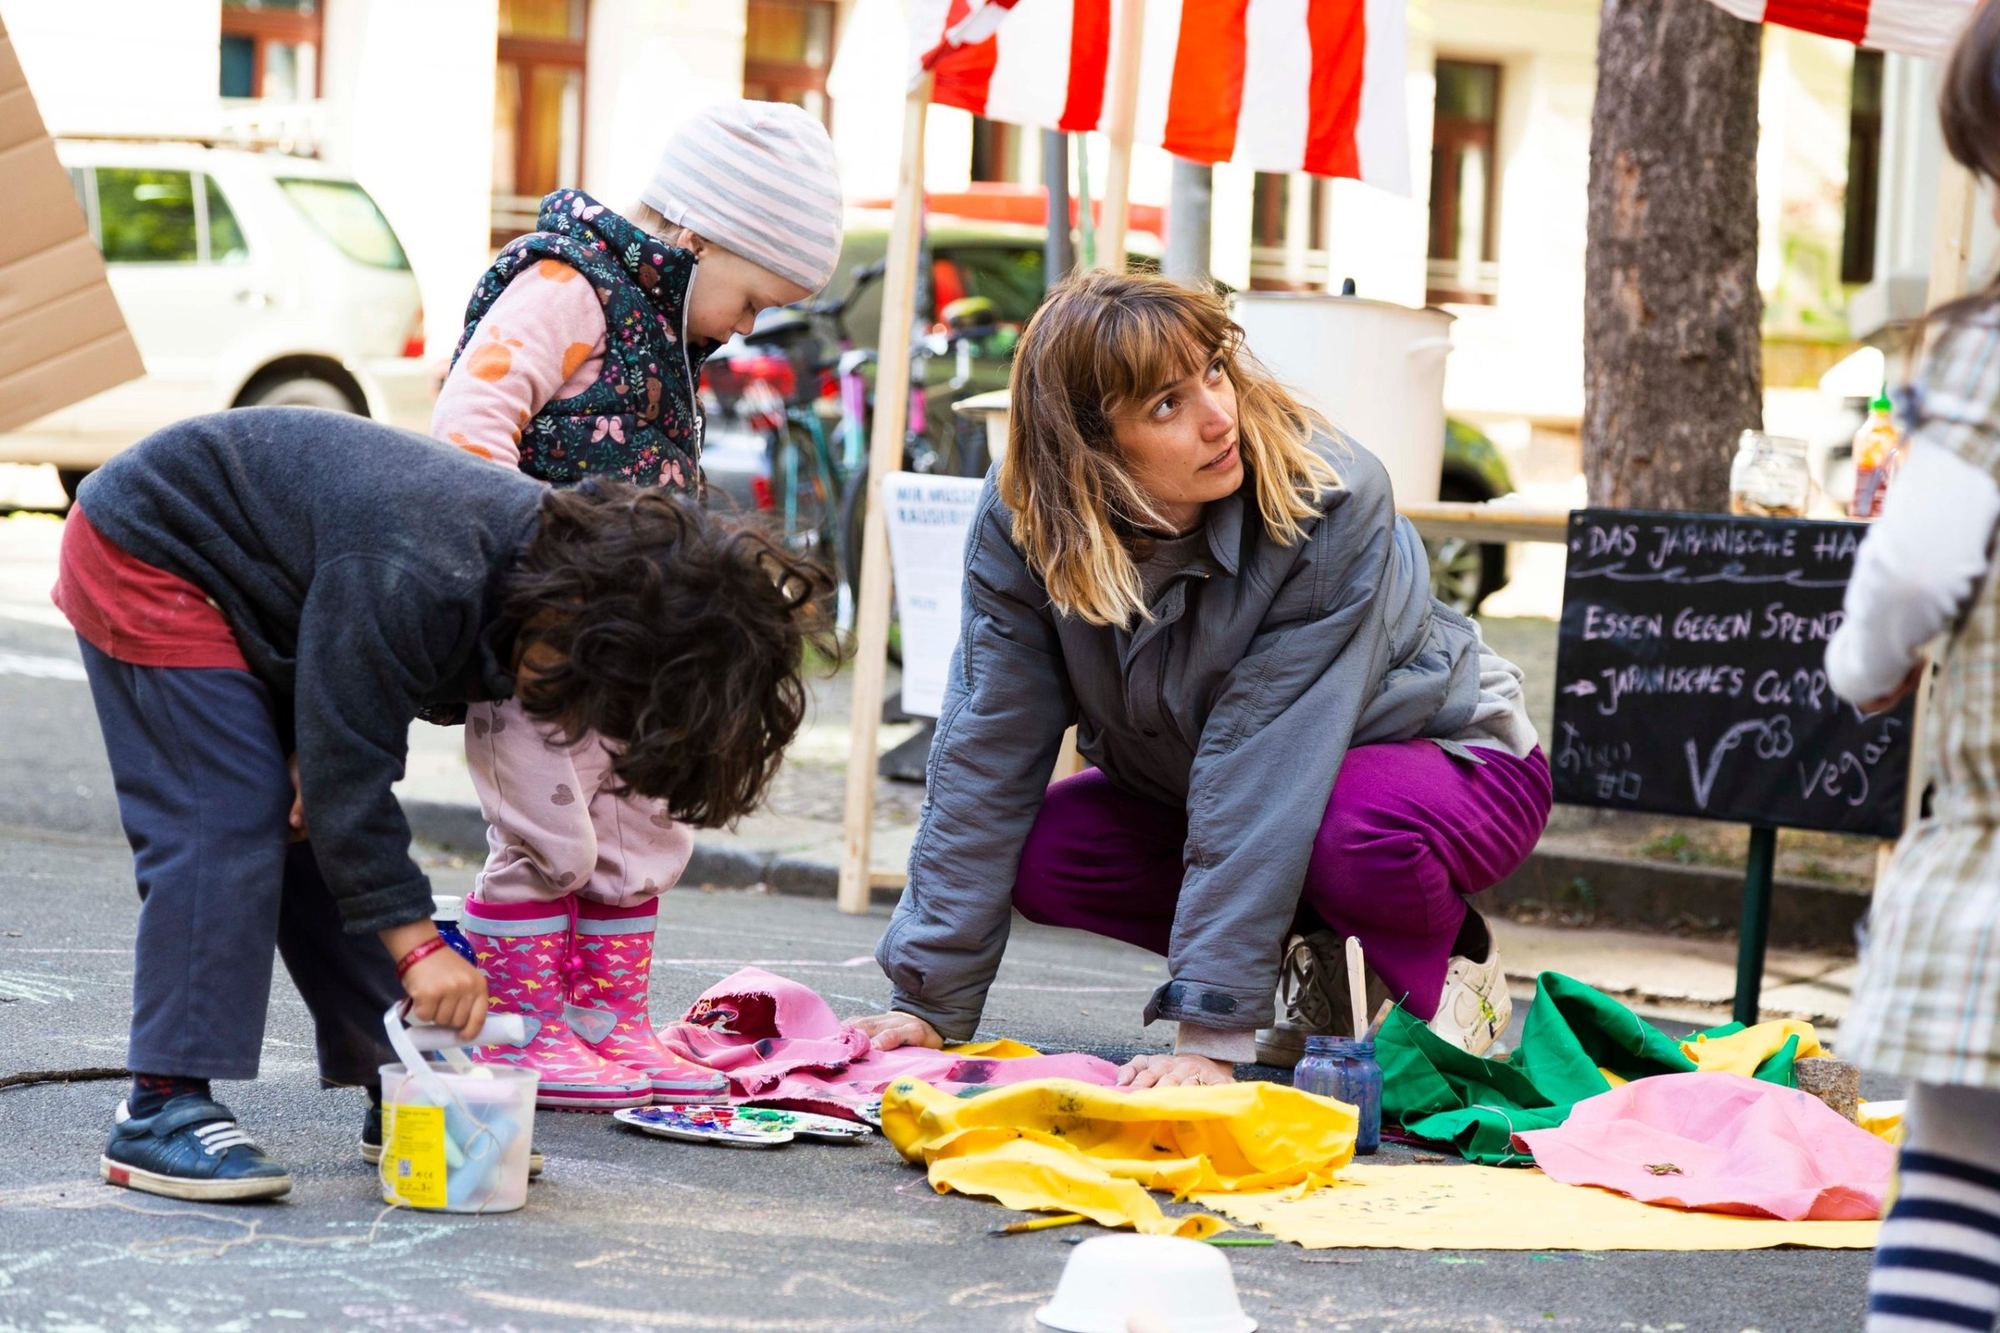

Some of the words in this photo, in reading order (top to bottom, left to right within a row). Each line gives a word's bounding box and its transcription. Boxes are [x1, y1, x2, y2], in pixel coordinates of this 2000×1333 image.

[1588, 524, 1640, 558] DAS
[1647, 525, 1798, 569] JAPANISCHE
[1812, 529, 1857, 561] HA
[1583, 605, 1663, 641] ESSEN
[1672, 606, 1753, 642] GEGEN
[1760, 601, 1846, 643] SPEND
[1598, 664, 1746, 716] JAPANISCHES
